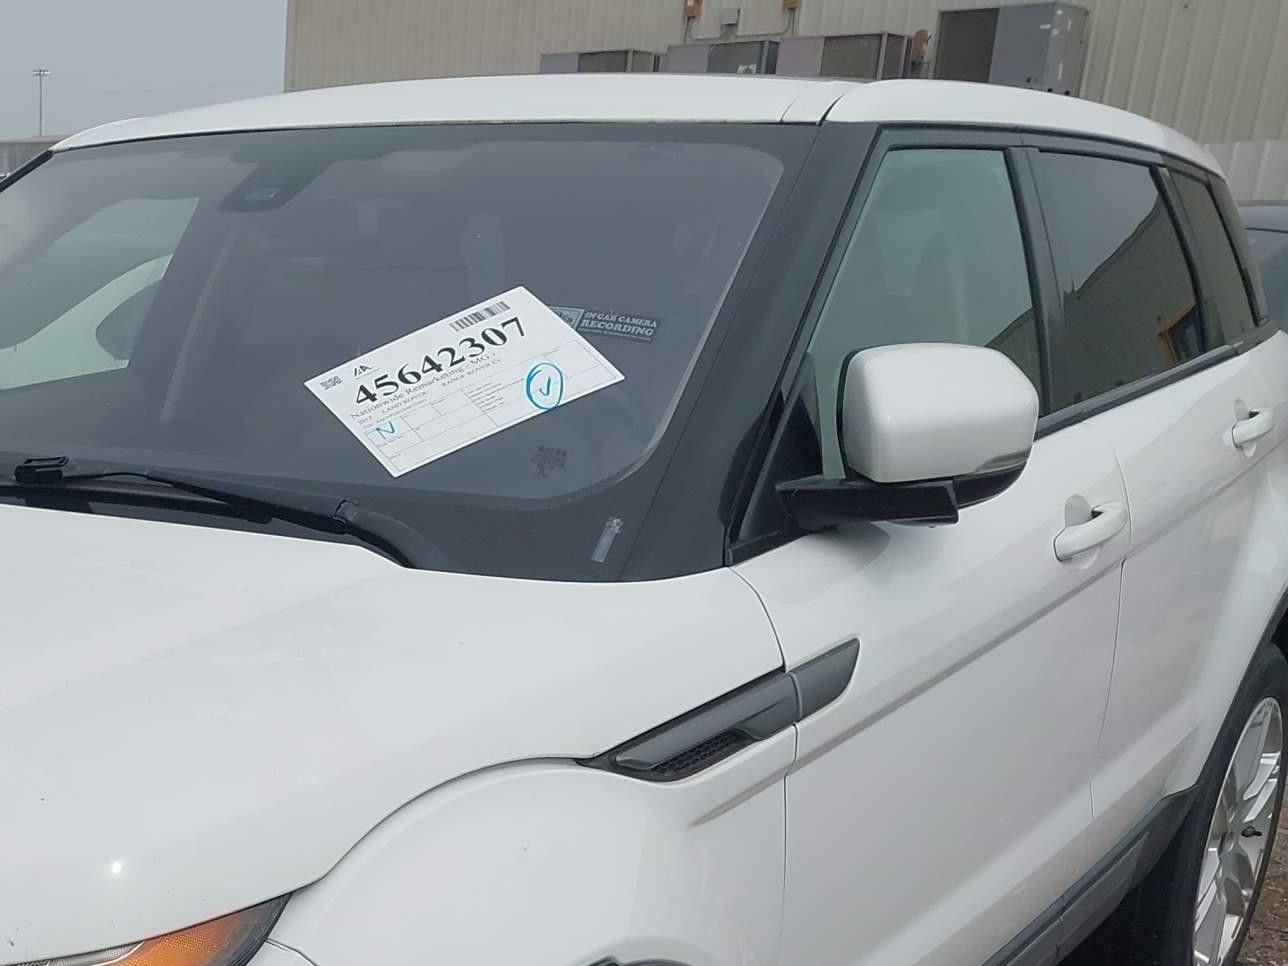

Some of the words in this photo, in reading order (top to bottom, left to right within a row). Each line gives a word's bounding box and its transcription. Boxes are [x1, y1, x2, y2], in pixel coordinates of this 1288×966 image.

[580, 319, 655, 336] RECORDING
[618, 315, 657, 327] CAMERA
[356, 316, 525, 404] 45642307
[350, 394, 404, 420] Nationwide
[405, 366, 465, 395] Remarketing
